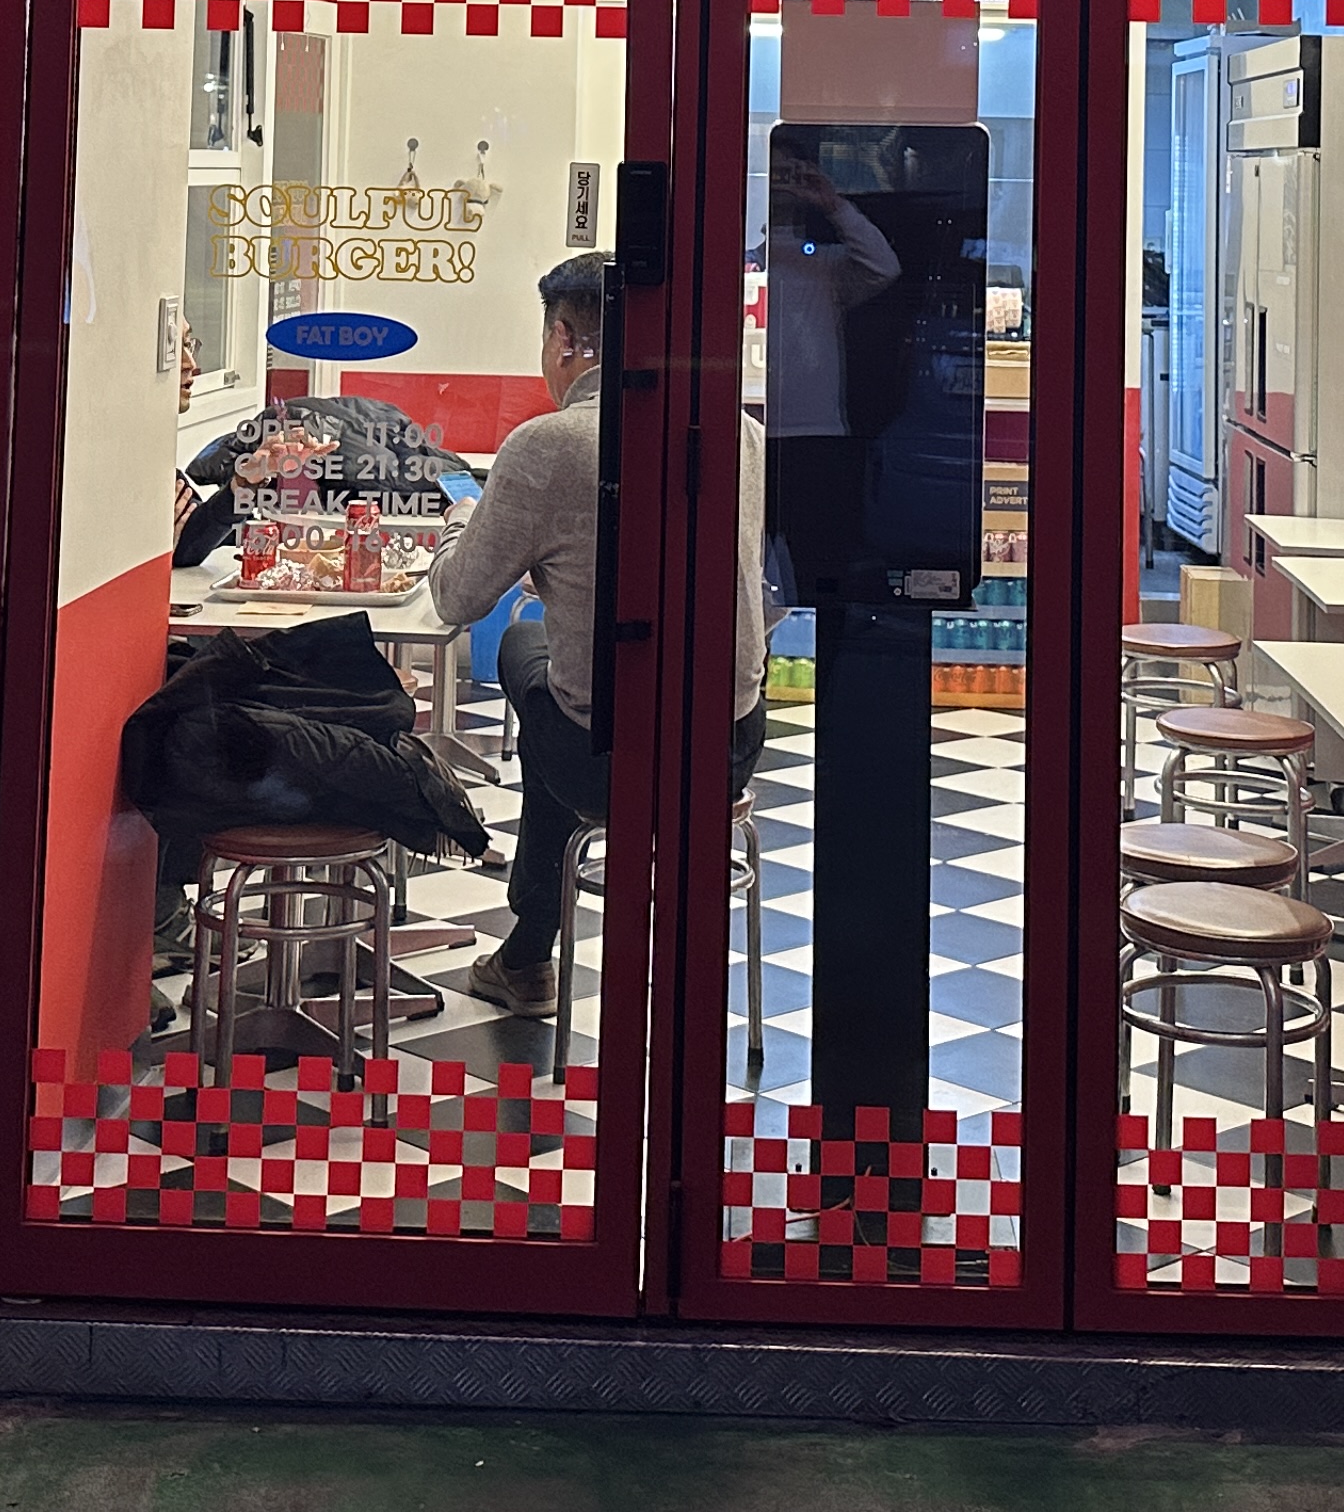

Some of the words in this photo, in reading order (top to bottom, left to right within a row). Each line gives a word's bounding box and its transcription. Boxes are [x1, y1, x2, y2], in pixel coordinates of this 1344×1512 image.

[208, 183, 483, 232] SOULFUL
[575, 170, 591, 229] 당기세요
[571, 234, 590, 242] PULL
[209, 234, 476, 283] BURGER!
[296, 325, 336, 345] FAT
[338, 326, 389, 346] BOY
[236, 419, 325, 443] OPEN
[365, 421, 444, 448] 11:00
[234, 453, 344, 483] CLOSE
[357, 454, 444, 482] 21:30
[234, 488, 350, 516] BREAK
[359, 491, 442, 517] TIME
[989, 486, 1019, 496] PRINT
